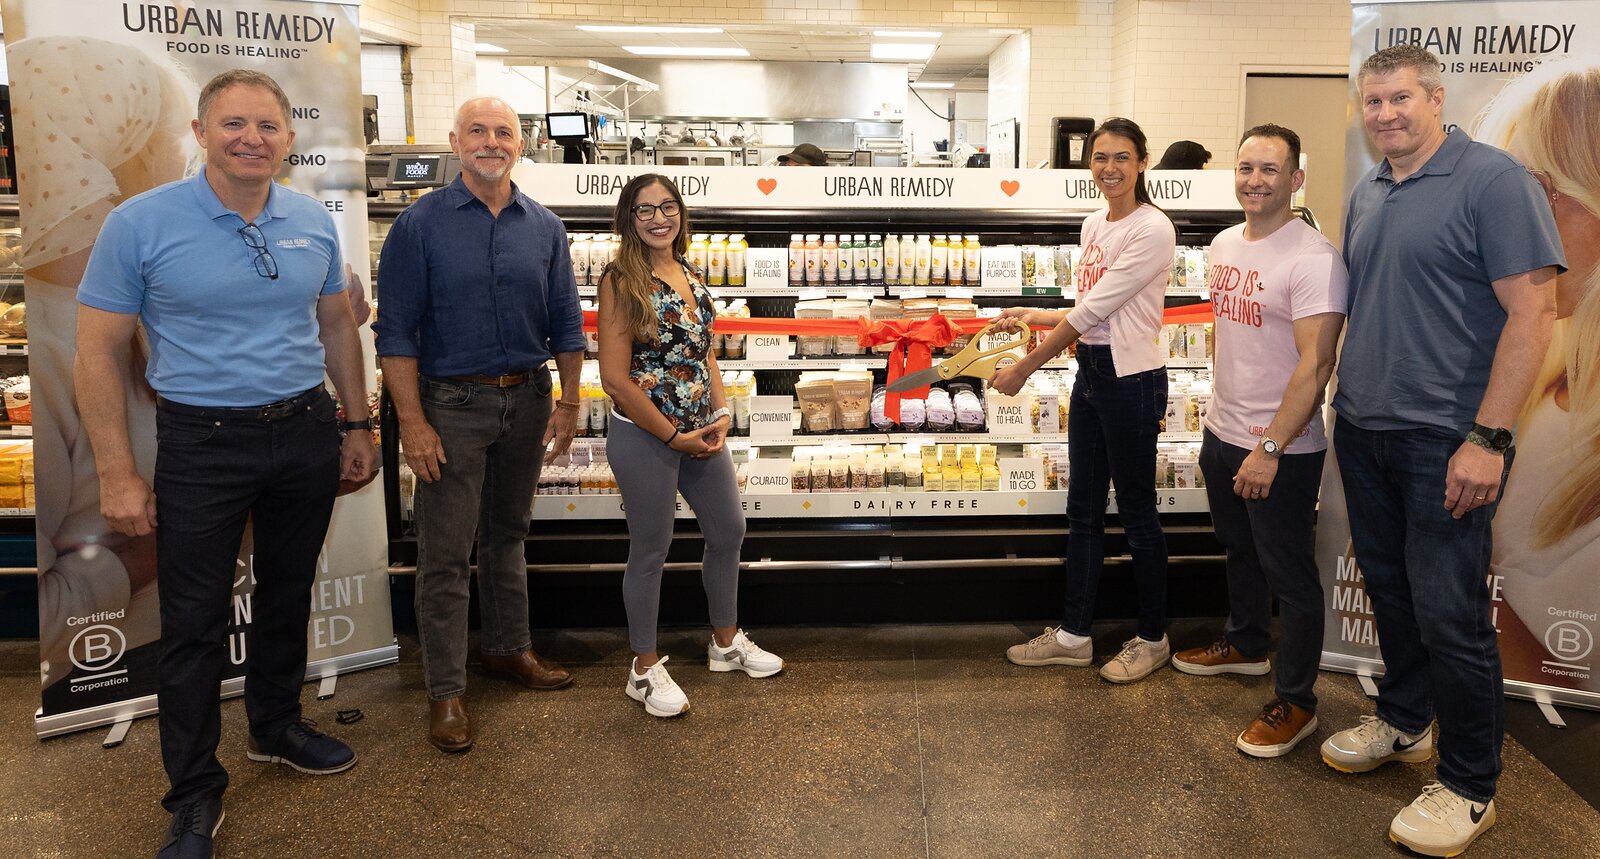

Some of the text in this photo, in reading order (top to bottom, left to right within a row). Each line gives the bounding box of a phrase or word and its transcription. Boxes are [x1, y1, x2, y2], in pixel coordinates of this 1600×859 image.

[122, 3, 335, 44] URBAN REMEDY
[1474, 24, 1576, 54] REMEDY
[166, 41, 210, 54] FOOD
[215, 44, 230, 55] IS
[1451, 62, 1465, 73] IS
[292, 107, 320, 119] NIC
[283, 154, 326, 166] -GMO
[576, 174, 710, 196] URBA EDY
[824, 176, 954, 197] URBAN REMEDY
[1065, 179, 1192, 199] URB MEDY
[325, 200, 344, 212] EE
[754, 259, 780, 269] FOOD IS
[987, 260, 1016, 269] EAT WITH
[753, 268, 782, 278] HEALING
[986, 268, 1017, 278] PURPOSE
[1242, 269, 1259, 297] IS
[755, 337, 780, 347] CLEAN
[997, 406, 1022, 415] MADE
[751, 412, 792, 423] CONVENIENT
[996, 415, 1024, 425] TO HEAL
[750, 475, 789, 486] CURATED
[1009, 471, 1035, 480] MADE
[1009, 480, 1017, 490] TO
[1018, 480, 1037, 490] GO
[741, 501, 761, 511] EE
[853, 499, 978, 510] DAIRY FREE
[66, 608, 125, 626] Certified
[1547, 606, 1598, 621] Certified
[1557, 627, 1581, 653] B
[84, 633, 113, 663] B
[1541, 666, 1590, 680] Corporation
[70, 676, 129, 693] Corporation
